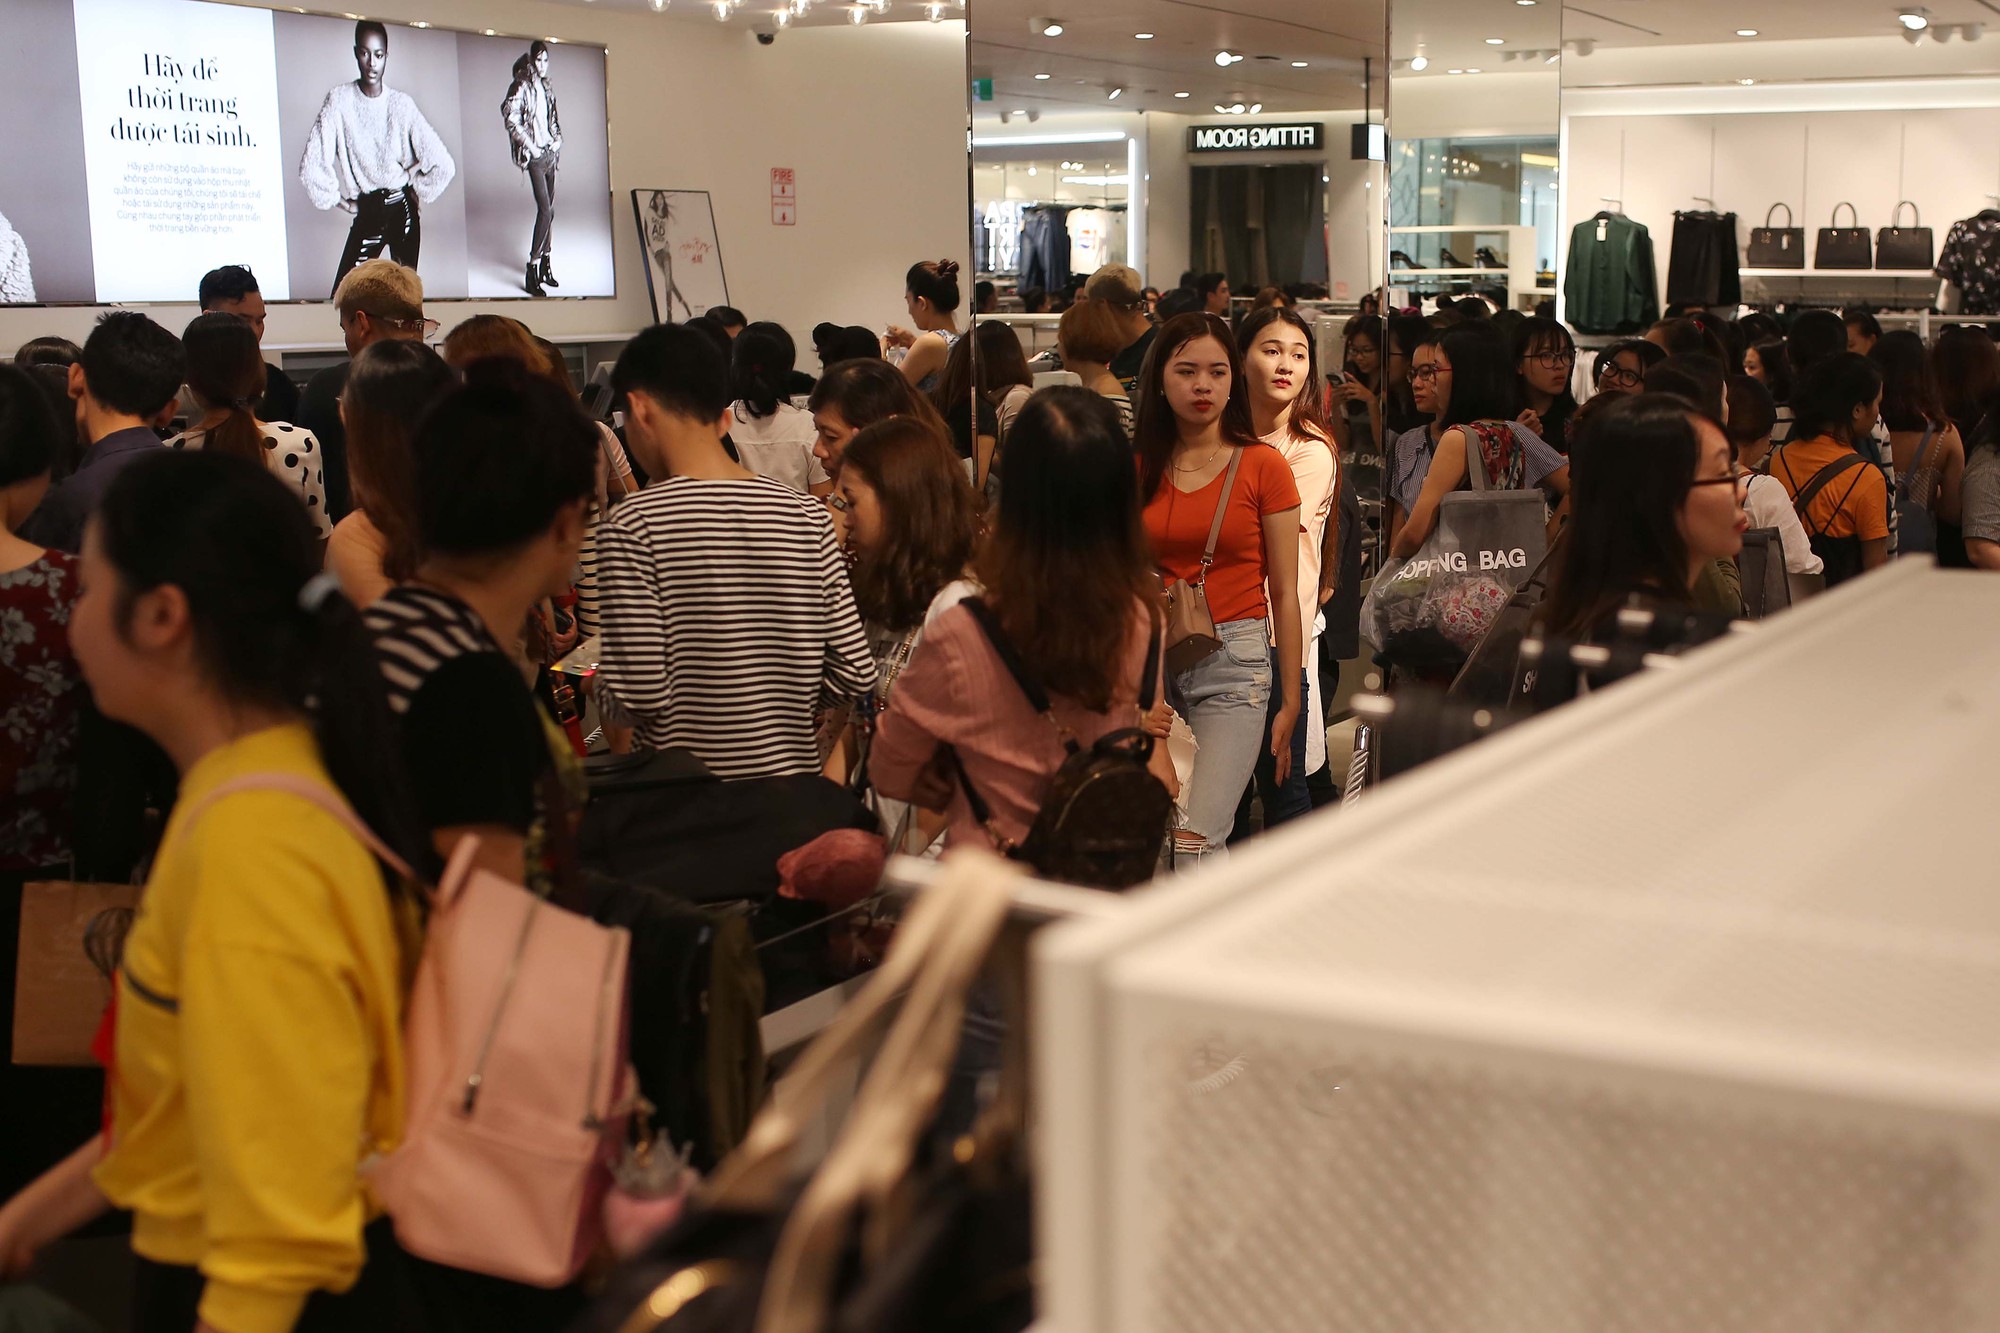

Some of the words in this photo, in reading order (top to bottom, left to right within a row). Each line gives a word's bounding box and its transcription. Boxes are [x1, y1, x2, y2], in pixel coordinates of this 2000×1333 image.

[144, 53, 184, 84] Hãy
[128, 85, 173, 110] thời
[180, 92, 238, 121] trang
[174, 122, 200, 144] tái
[206, 125, 257, 147] sinh.
[773, 170, 793, 181] FIRE
[1479, 548, 1527, 570] BAG
